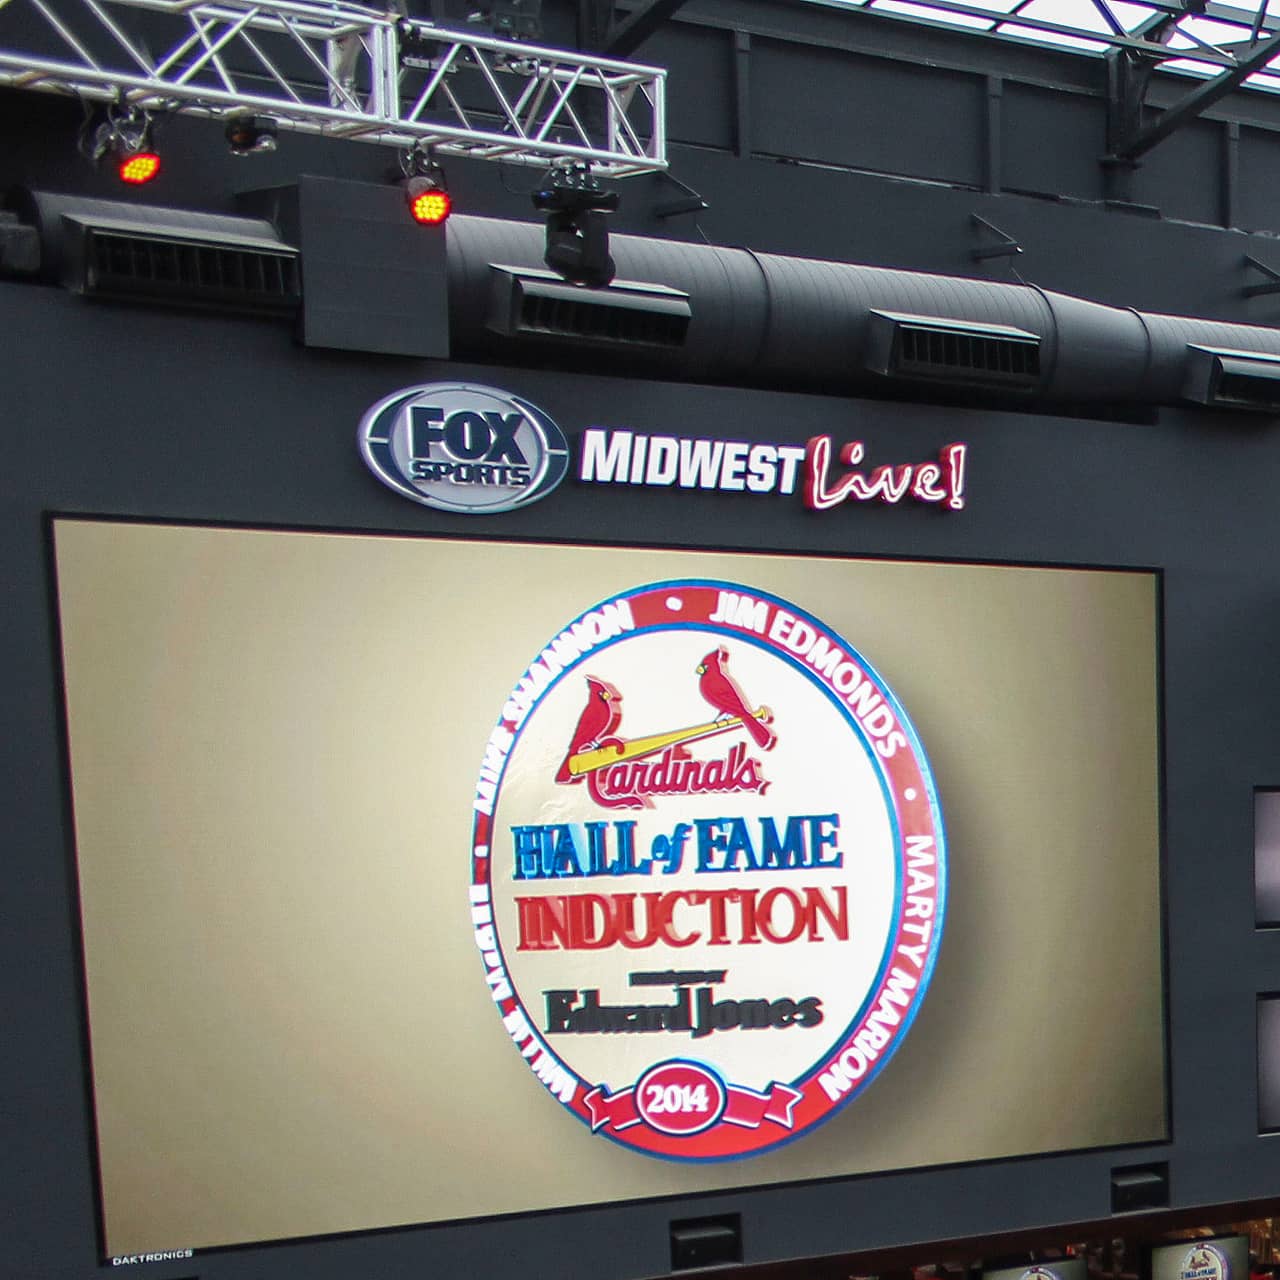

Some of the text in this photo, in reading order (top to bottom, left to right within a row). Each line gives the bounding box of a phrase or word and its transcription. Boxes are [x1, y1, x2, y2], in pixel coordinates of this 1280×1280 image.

[411, 406, 524, 462] FOX
[411, 459, 529, 488] SPORTS
[580, 428, 967, 511] MIDWEST Live!
[502, 600, 635, 730] SHANNON
[710, 591, 906, 758] JIM EDMONDS
[585, 741, 772, 810] Cardinals
[510, 813, 844, 880] HALL of FAME
[514, 886, 849, 951] INDUCTION
[818, 834, 935, 1101] MARTY MARION
[646, 1084, 710, 1114] 2014
[112, 1248, 194, 1267] DAKTRONICS
